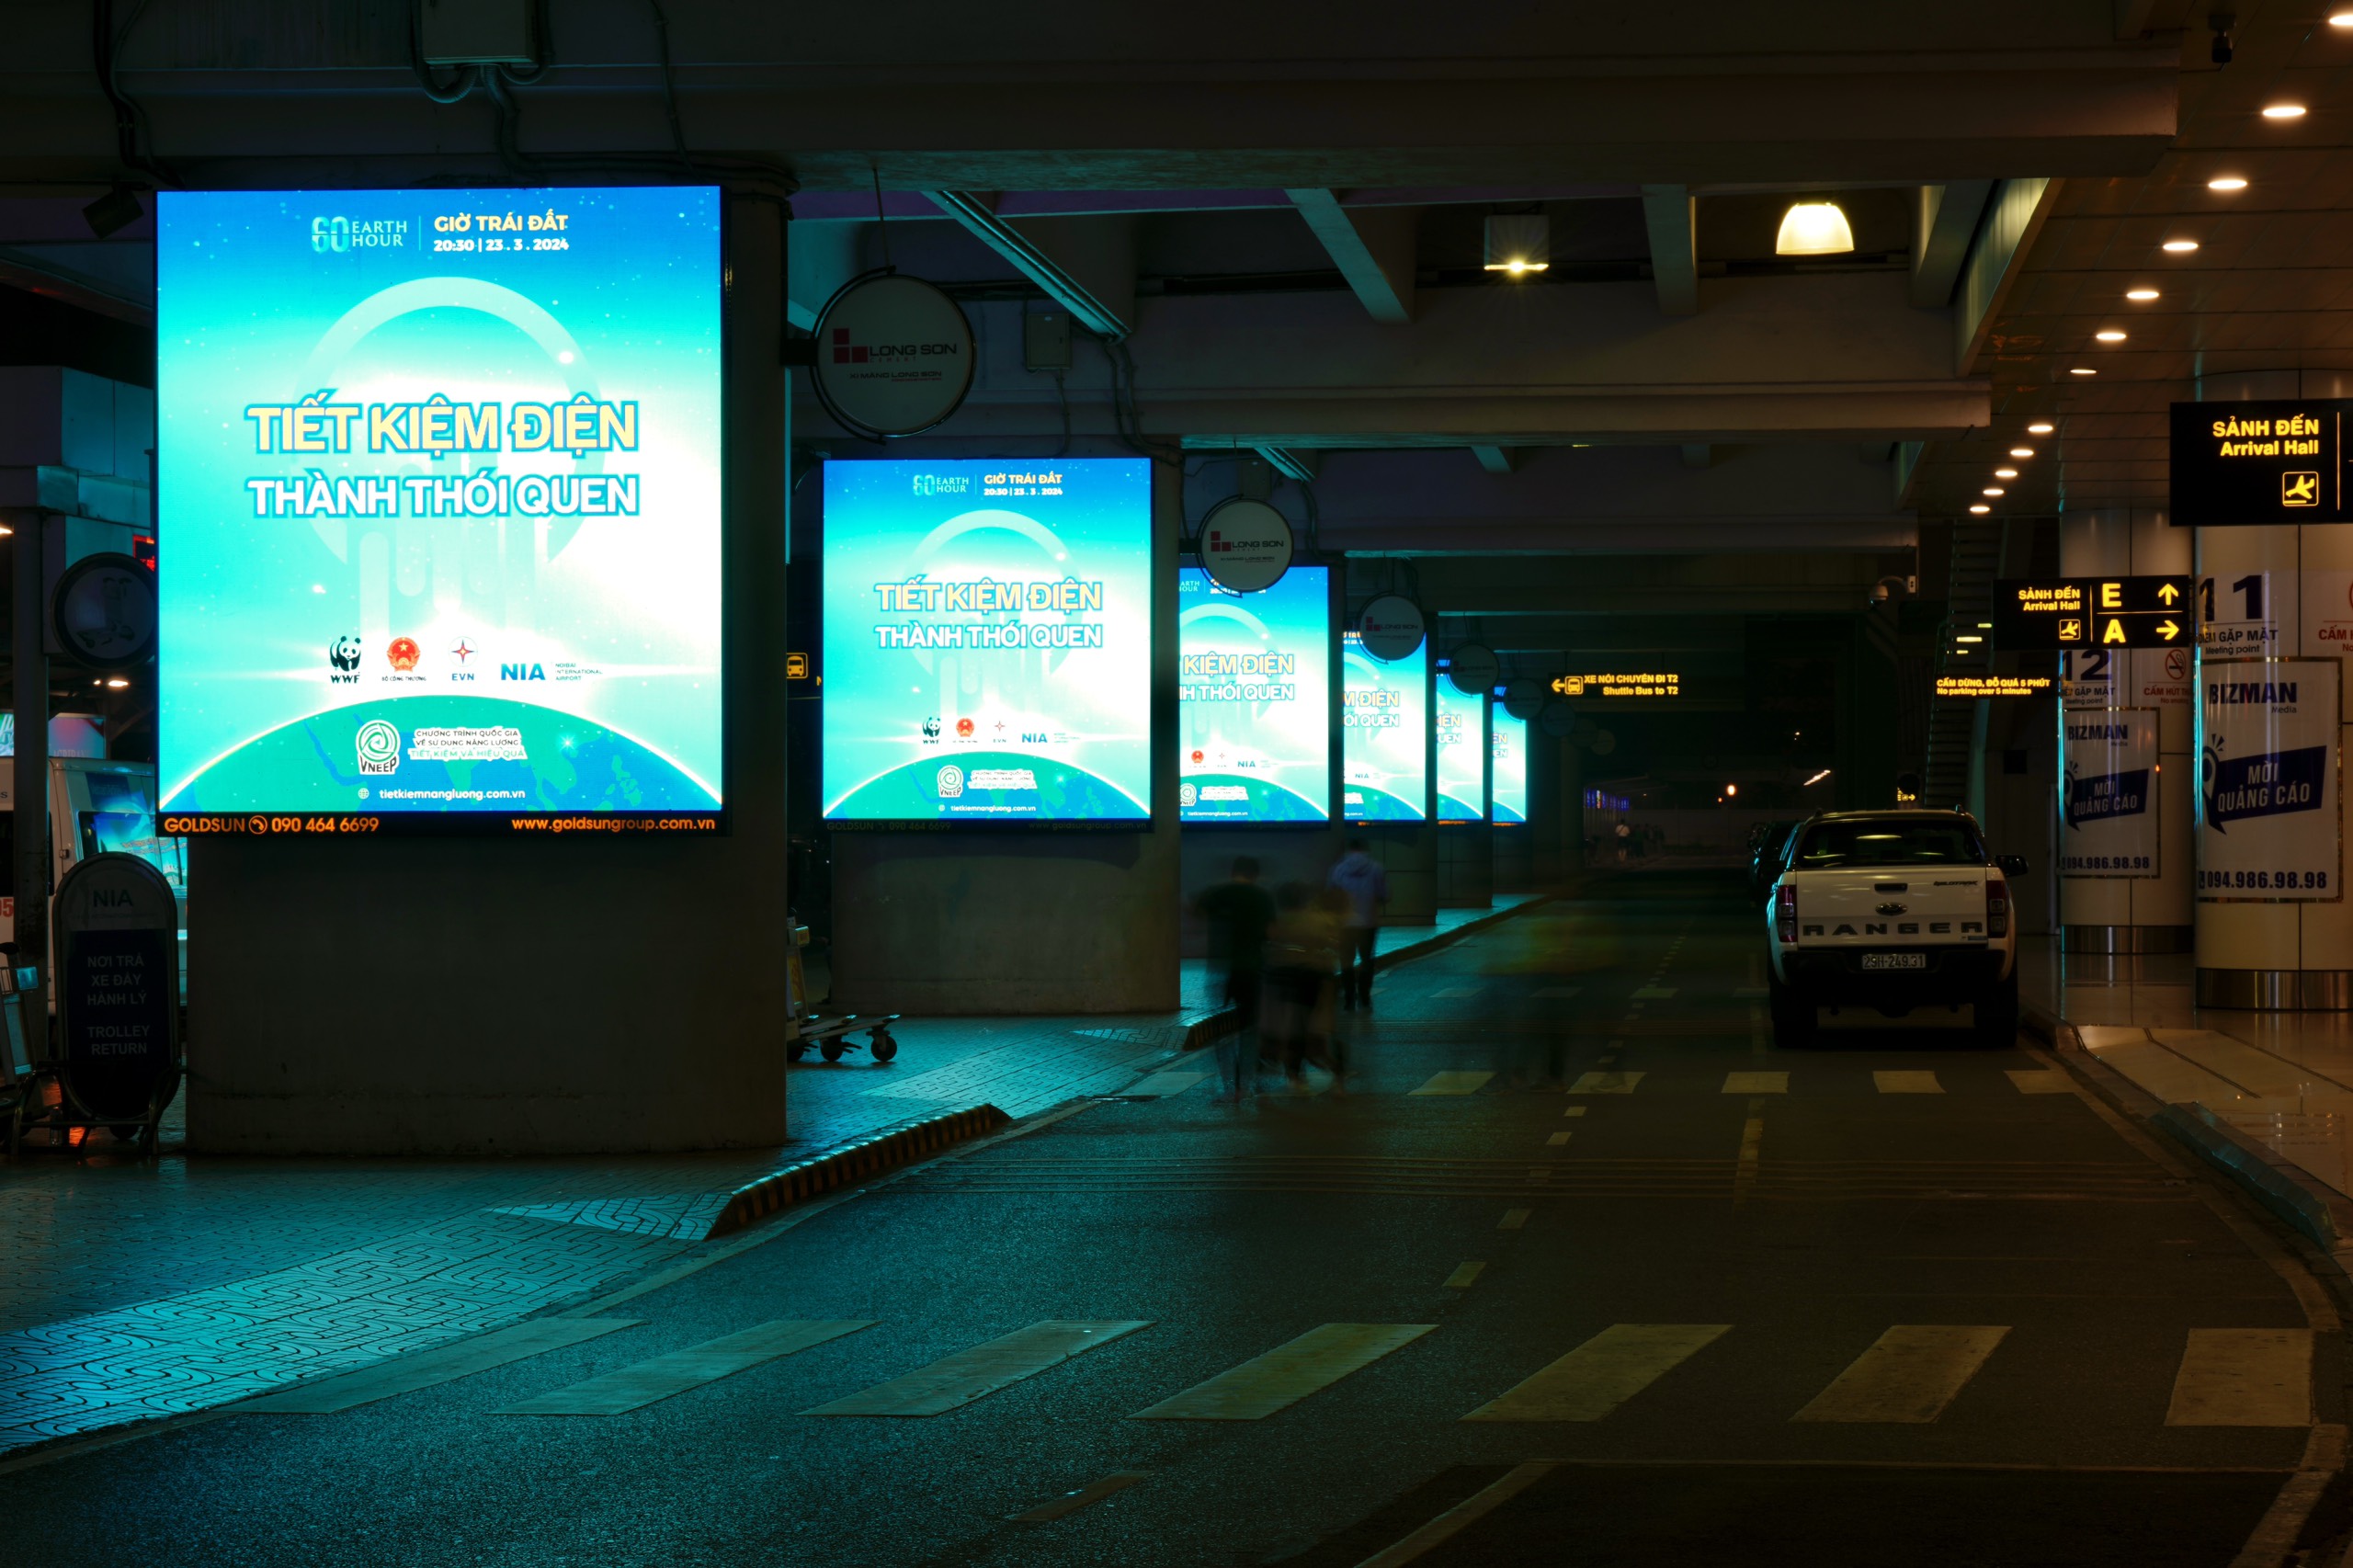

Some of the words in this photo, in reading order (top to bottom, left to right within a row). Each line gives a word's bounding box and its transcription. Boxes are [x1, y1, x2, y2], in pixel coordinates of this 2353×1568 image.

[352, 221, 407, 233] EARTH
[434, 212, 471, 232] GIỜ
[475, 212, 522, 232] TRÁI
[528, 209, 568, 231] ĐẤT
[352, 234, 404, 246] HOUR
[434, 240, 474, 252] 20:30
[870, 345, 916, 357] LONG
[921, 343, 957, 355] SON
[245, 389, 362, 453] TIẾT
[367, 393, 501, 459] KIỆM
[507, 392, 639, 459] ĐIỆN
[2212, 415, 2269, 437] SẢNH
[2275, 413, 2319, 436] ĐẾN
[2220, 440, 2279, 456] Arrival
[2284, 439, 2318, 455] Hall
[937, 477, 969, 485] EARTH
[983, 473, 1006, 484] GIỜ
[1008, 472, 1036, 483] TRÁI
[1039, 471, 1063, 483] ĐẤT
[245, 469, 401, 517] THÀNH
[403, 468, 512, 516] THÓI
[515, 475, 640, 517] QUEN
[874, 574, 943, 612] TIẾT
[945, 578, 1026, 616] KIỆM
[1027, 577, 1102, 615] ĐIỆN
[2018, 586, 2052, 600] SẢNH
[2055, 585, 2081, 599] ĐẾN
[2102, 583, 2122, 608] E
[2023, 602, 2058, 611] Arrival
[2060, 601, 2081, 610] Hall
[873, 620, 965, 649] THÀNH
[965, 620, 1029, 648] THÓI
[1029, 625, 1102, 649] QUEN
[2103, 619, 2126, 643] A
[2219, 629, 2243, 644] GẶP
[2247, 628, 2279, 644] MẶT
[2318, 624, 2347, 640] CẤM
[2236, 645, 2259, 654] point
[1184, 651, 1237, 677] KIỆM
[1240, 650, 1294, 677] ĐIỆN
[451, 673, 474, 681] EVN
[500, 663, 546, 681] NIA
[1584, 675, 1597, 683] XE
[1667, 675, 1678, 683] T2
[330, 675, 360, 684] WWF
[1937, 677, 1956, 687] CẤM
[2000, 678, 2018, 687] QUÁ
[2028, 678, 2051, 687] PHÚT
[1198, 681, 1241, 700] THÓI
[1243, 684, 1294, 700] QUEN
[1603, 687, 1634, 695] Shuttle
[1635, 687, 1653, 695] Bus
[1654, 687, 1665, 695] to
[1666, 686, 1678, 695] T2
[1949, 687, 1977, 696] parking
[2143, 685, 2164, 696] CẤM
[2209, 682, 2297, 704] BIZMAN
[1358, 688, 1399, 709] ĐIỆN
[2271, 706, 2297, 714] Media
[1360, 713, 1399, 727] QUEN
[479, 729, 503, 737] QUỐC
[1021, 733, 1048, 744] NIA
[1438, 733, 1461, 744] UEN
[2068, 725, 2128, 740] BIZMAN
[359, 755, 397, 773] VNEEP
[2247, 760, 2279, 785] MỜI
[380, 790, 525, 801] tietkiemnangluong.com.vn
[939, 786, 961, 796] VNEEP
[2217, 785, 2268, 812] QUẢNG
[2276, 779, 2311, 806] CÁO
[2074, 798, 2109, 816] QUẢNG
[2113, 793, 2138, 811] CÁO
[165, 818, 244, 833] GOLDSUN
[272, 818, 301, 832] 090
[305, 818, 335, 832] 464
[340, 818, 379, 832] 6699
[512, 817, 715, 833] www.goldsungroup.com.vn
[827, 821, 874, 831] GOLDSUN
[889, 821, 906, 831] 090
[2207, 871, 2327, 889] 094.986.98.98
[94, 890, 133, 907] NIA
[1803, 922, 1983, 936] RANGER
[91, 974, 109, 986] XE
[87, 991, 126, 1006] HÀNH
[130, 989, 147, 1005] LÝ
[87, 1025, 151, 1039] TROLLEY
[91, 1042, 147, 1056] RETURN
